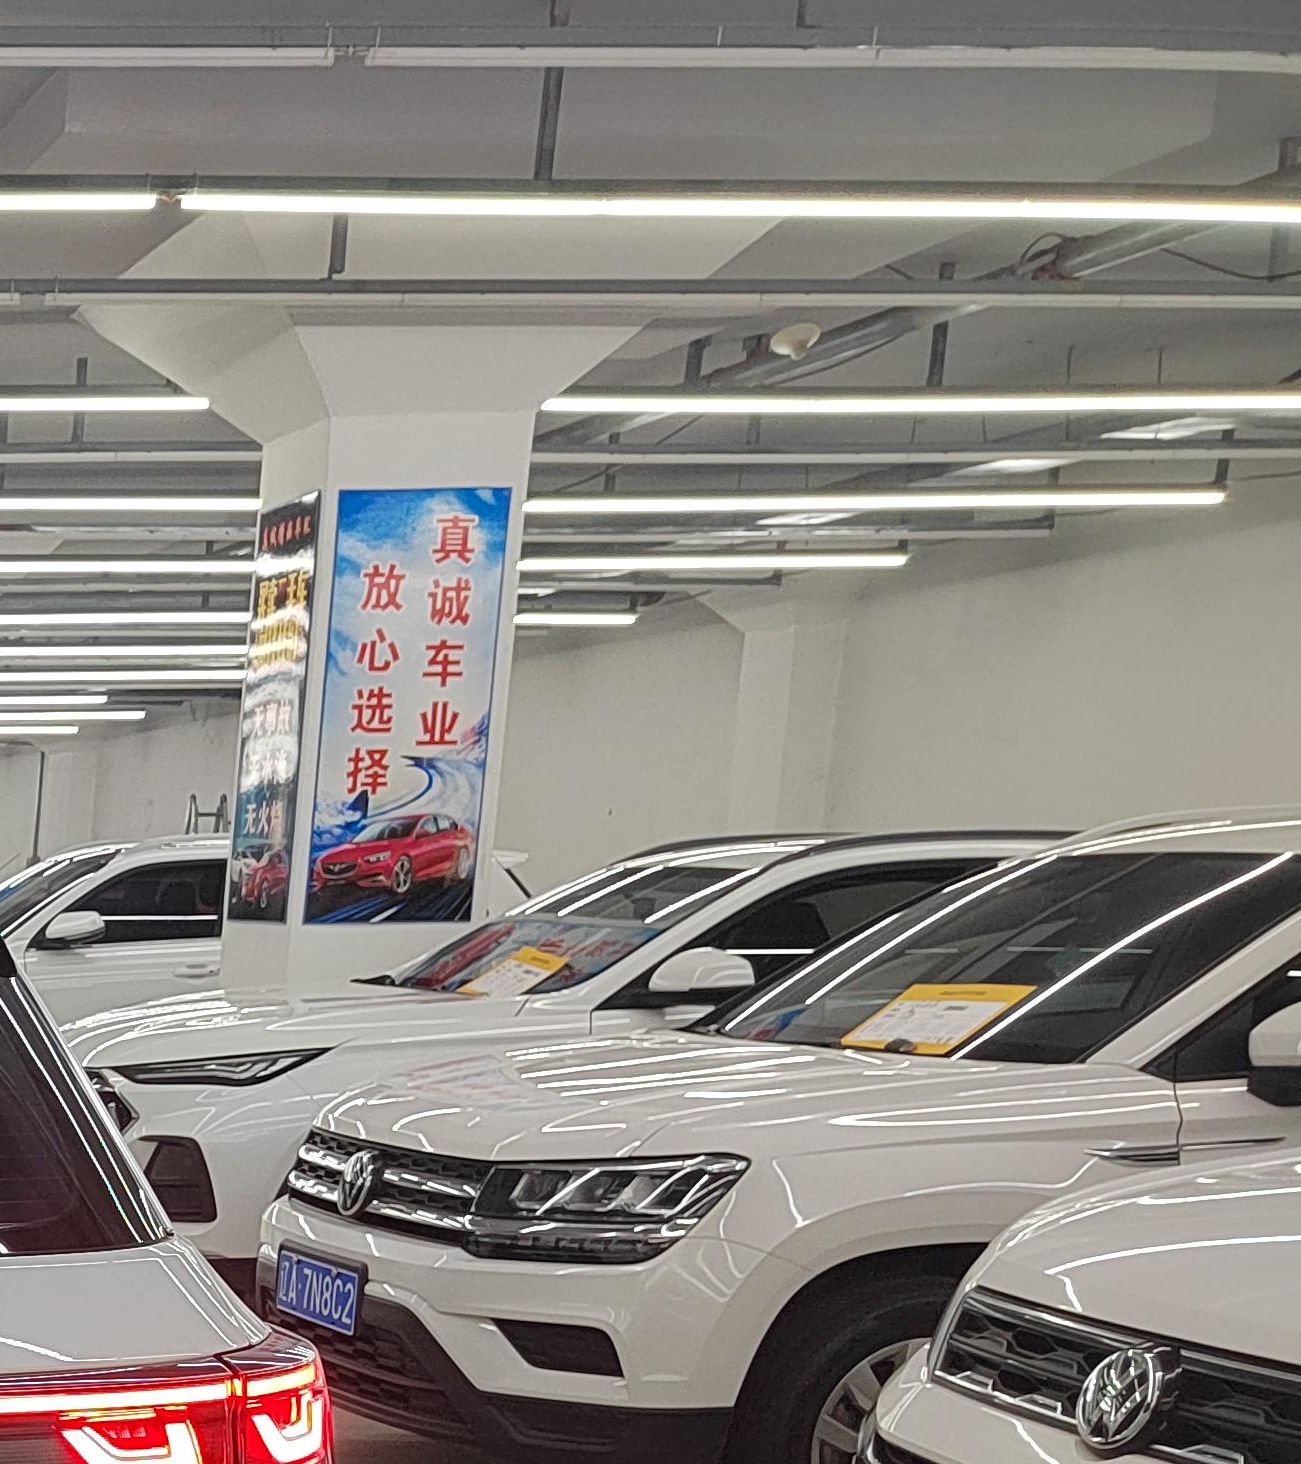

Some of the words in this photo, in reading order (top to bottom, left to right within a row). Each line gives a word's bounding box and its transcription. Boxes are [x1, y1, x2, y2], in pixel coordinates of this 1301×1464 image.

[346, 563, 406, 796] 放心选择
[415, 514, 476, 748] 真诚车业
[279, 1261, 354, 1325] 辽A·7N8C2
